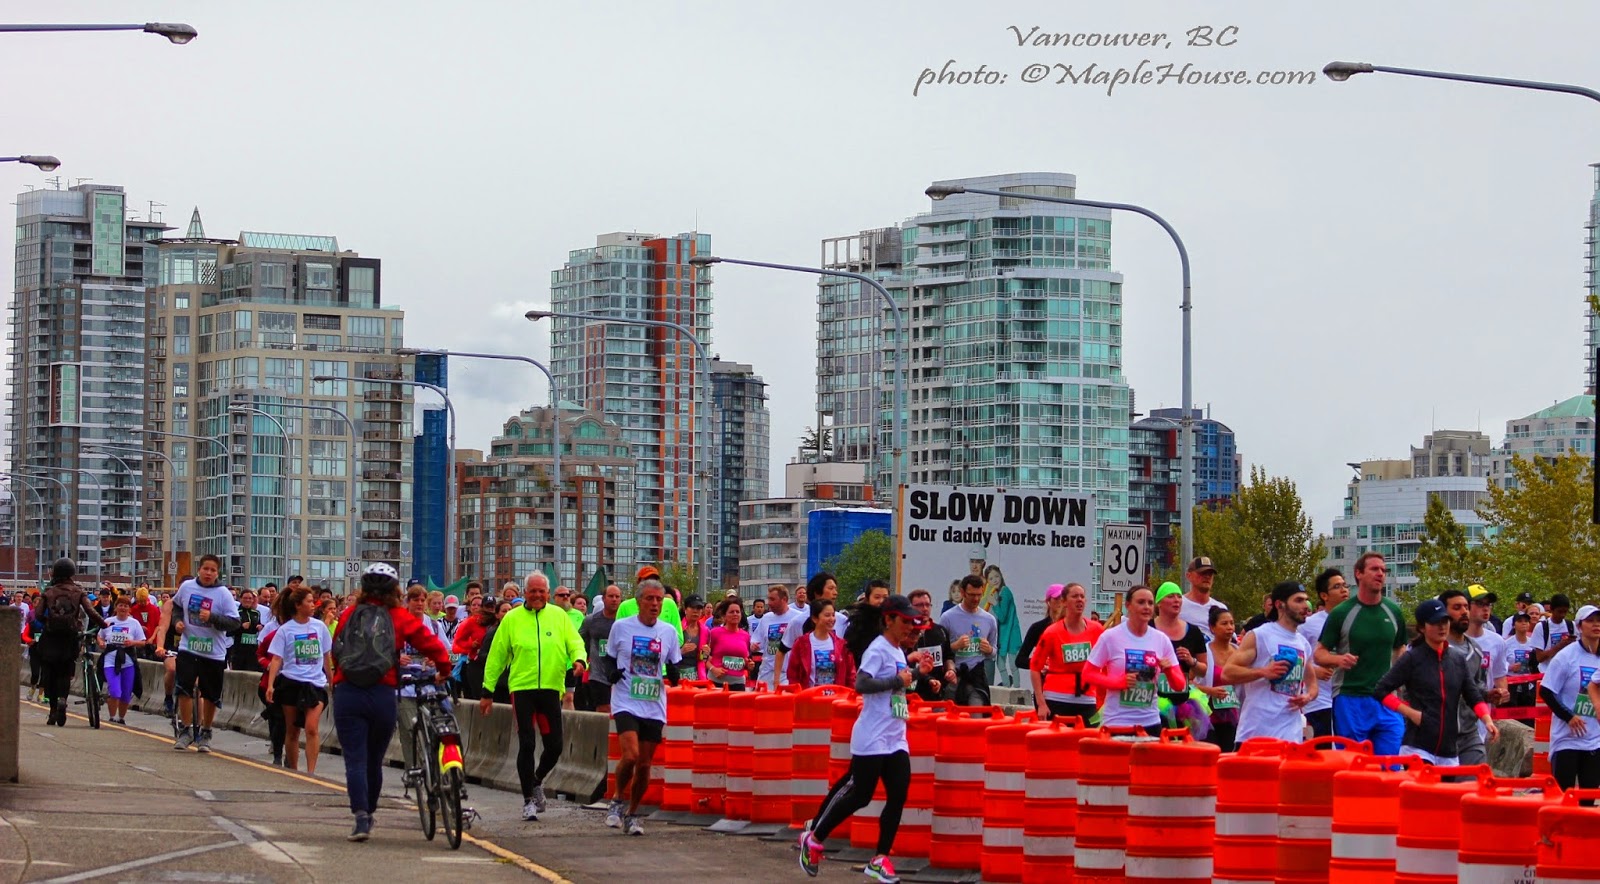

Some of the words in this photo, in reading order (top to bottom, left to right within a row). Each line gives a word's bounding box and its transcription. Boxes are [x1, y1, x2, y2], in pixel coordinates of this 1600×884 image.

[910, 490, 994, 522] SLOW
[1003, 494, 1087, 527] DOWN
[909, 524, 937, 542] Our
[942, 526, 992, 548] daddy
[997, 529, 1046, 547] works
[1051, 530, 1085, 548] here
[1108, 529, 1142, 541] MAXIMUM
[1108, 543, 1139, 575] 30
[346, 562, 360, 572] 30
[1112, 579, 1133, 588] km/h
[189, 640, 212, 653] 10076
[296, 644, 319, 655] 14509
[1065, 647, 1090, 661] 8841
[632, 682, 660, 697] 16173
[1123, 688, 1153, 703] 17294
[1577, 701, 1595, 716] 167
